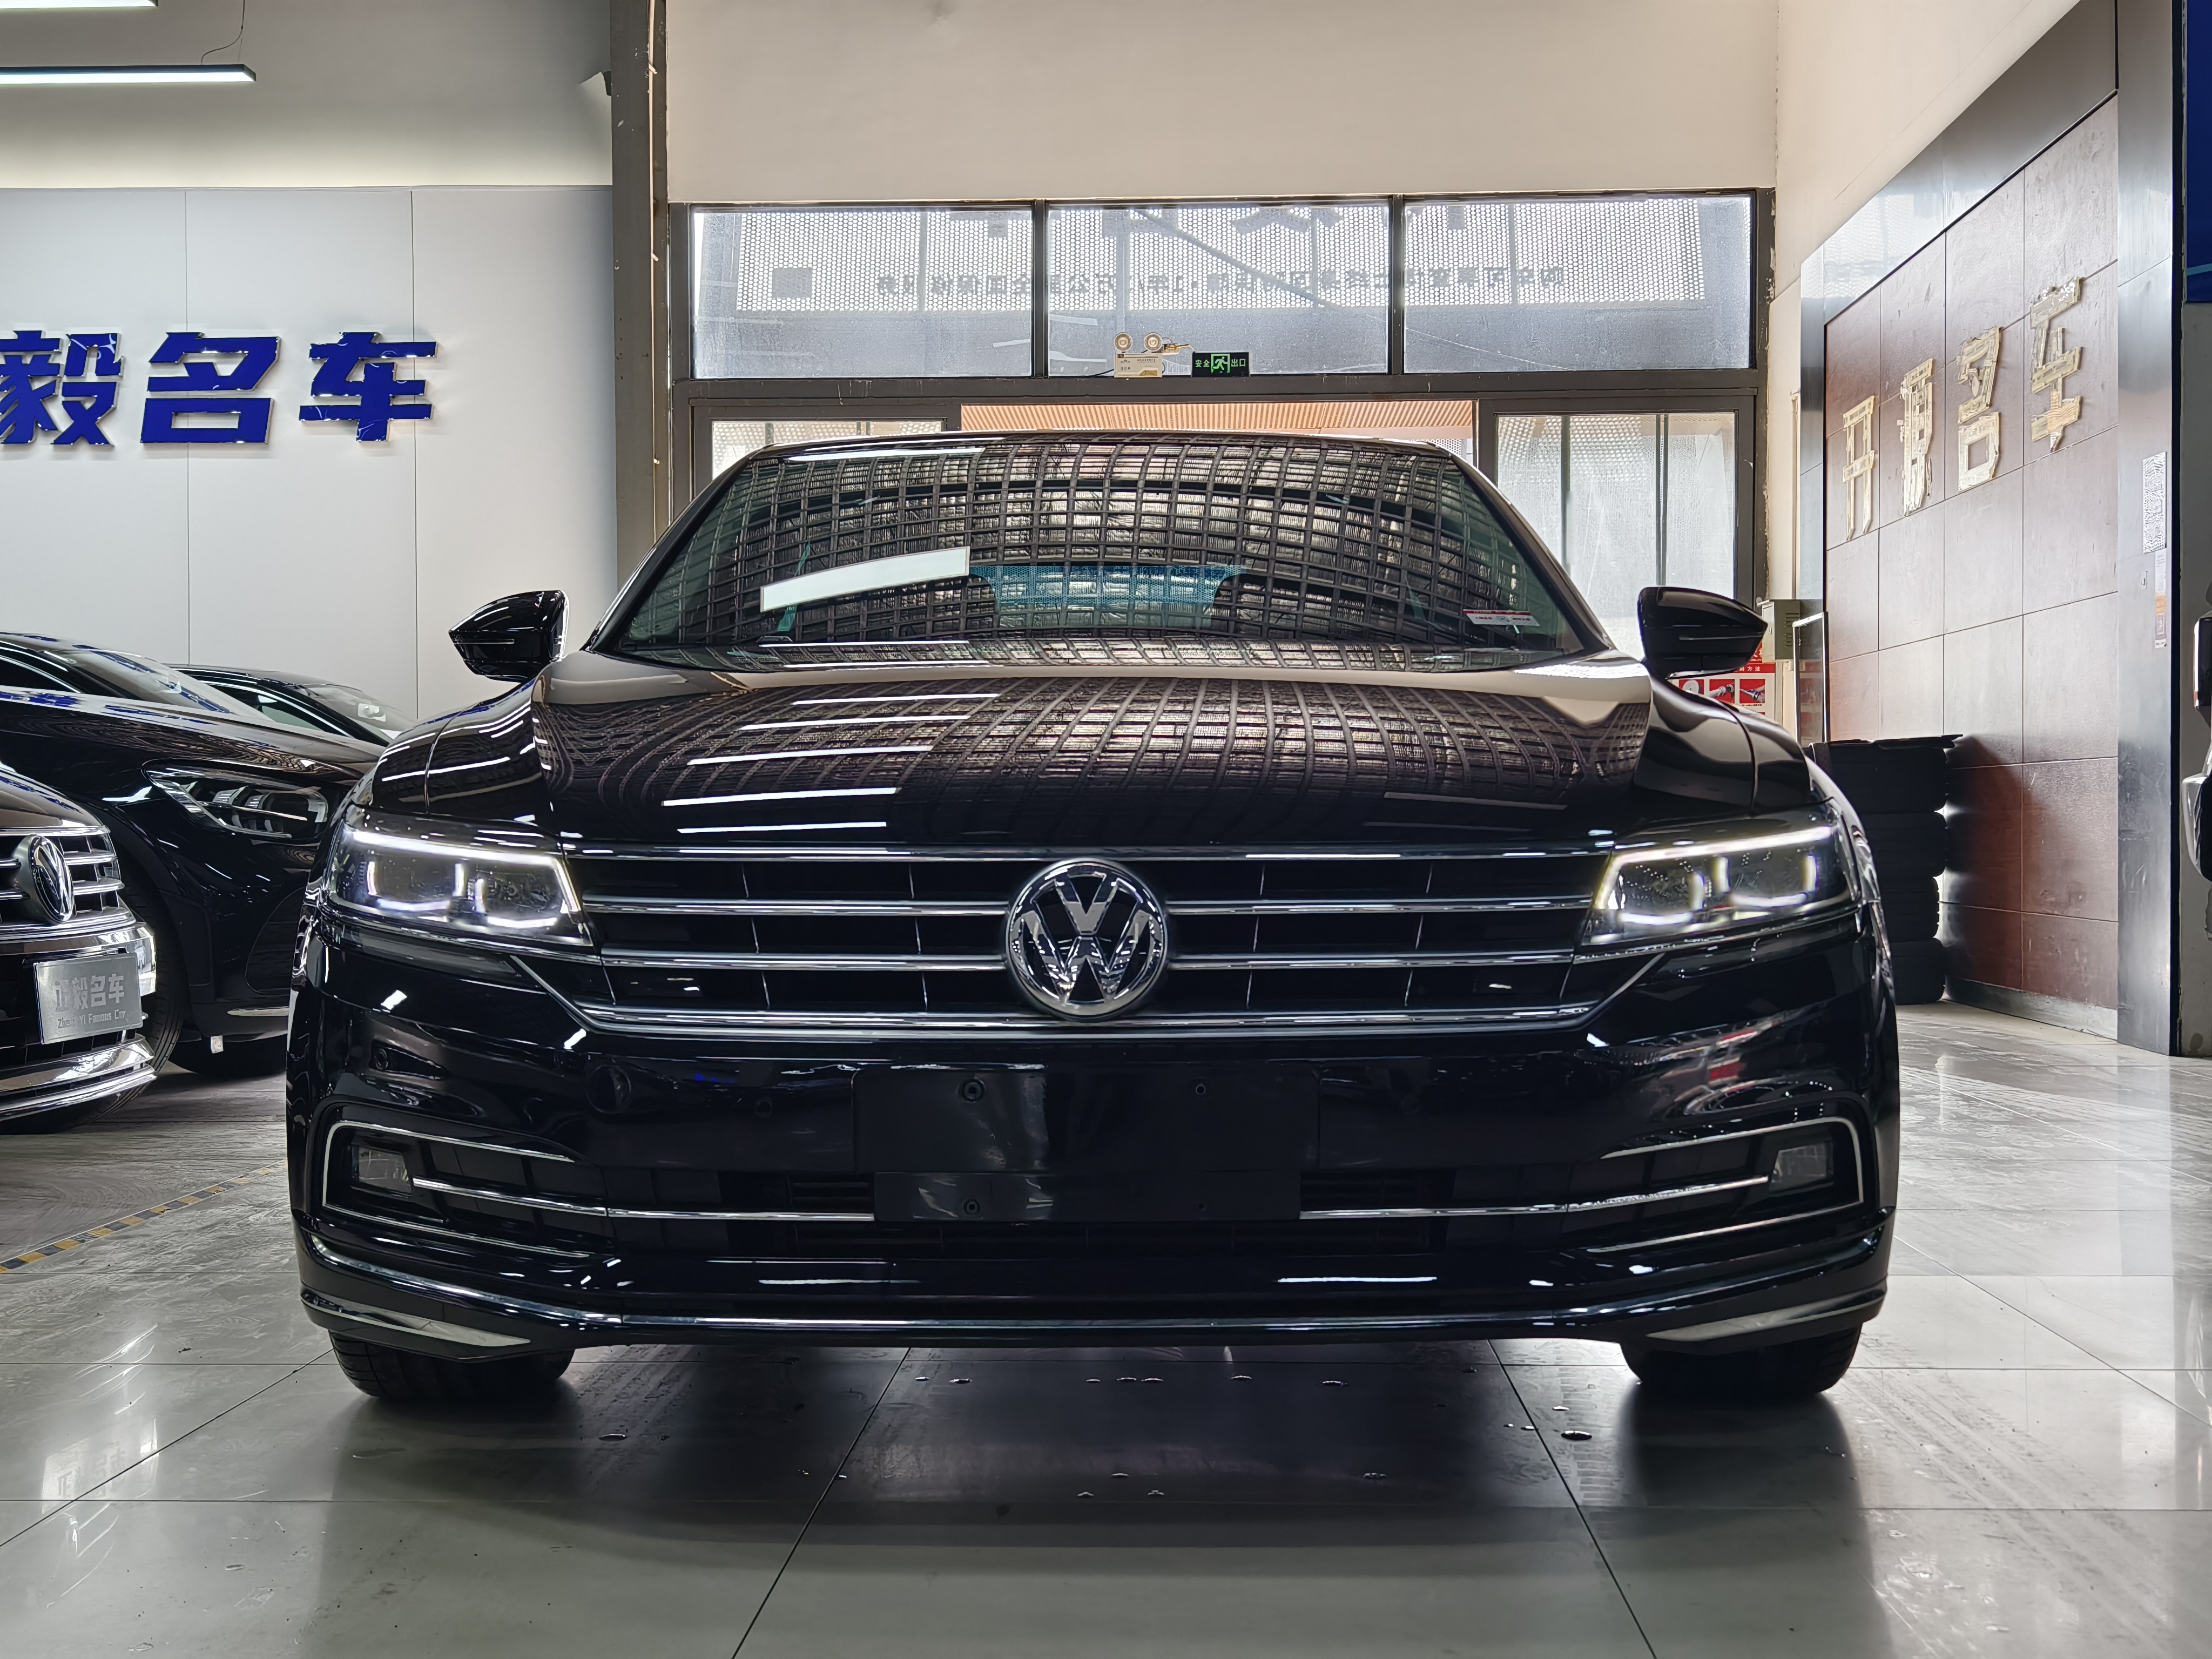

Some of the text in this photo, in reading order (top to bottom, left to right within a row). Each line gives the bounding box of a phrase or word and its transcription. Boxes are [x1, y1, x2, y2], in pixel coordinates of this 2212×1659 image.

[0, 329, 440, 446] 毅名车
[1195, 359, 1246, 368] 安全 出口
[1006, 857, 1169, 1019] VW
[89, 1012, 112, 1024] Famous
